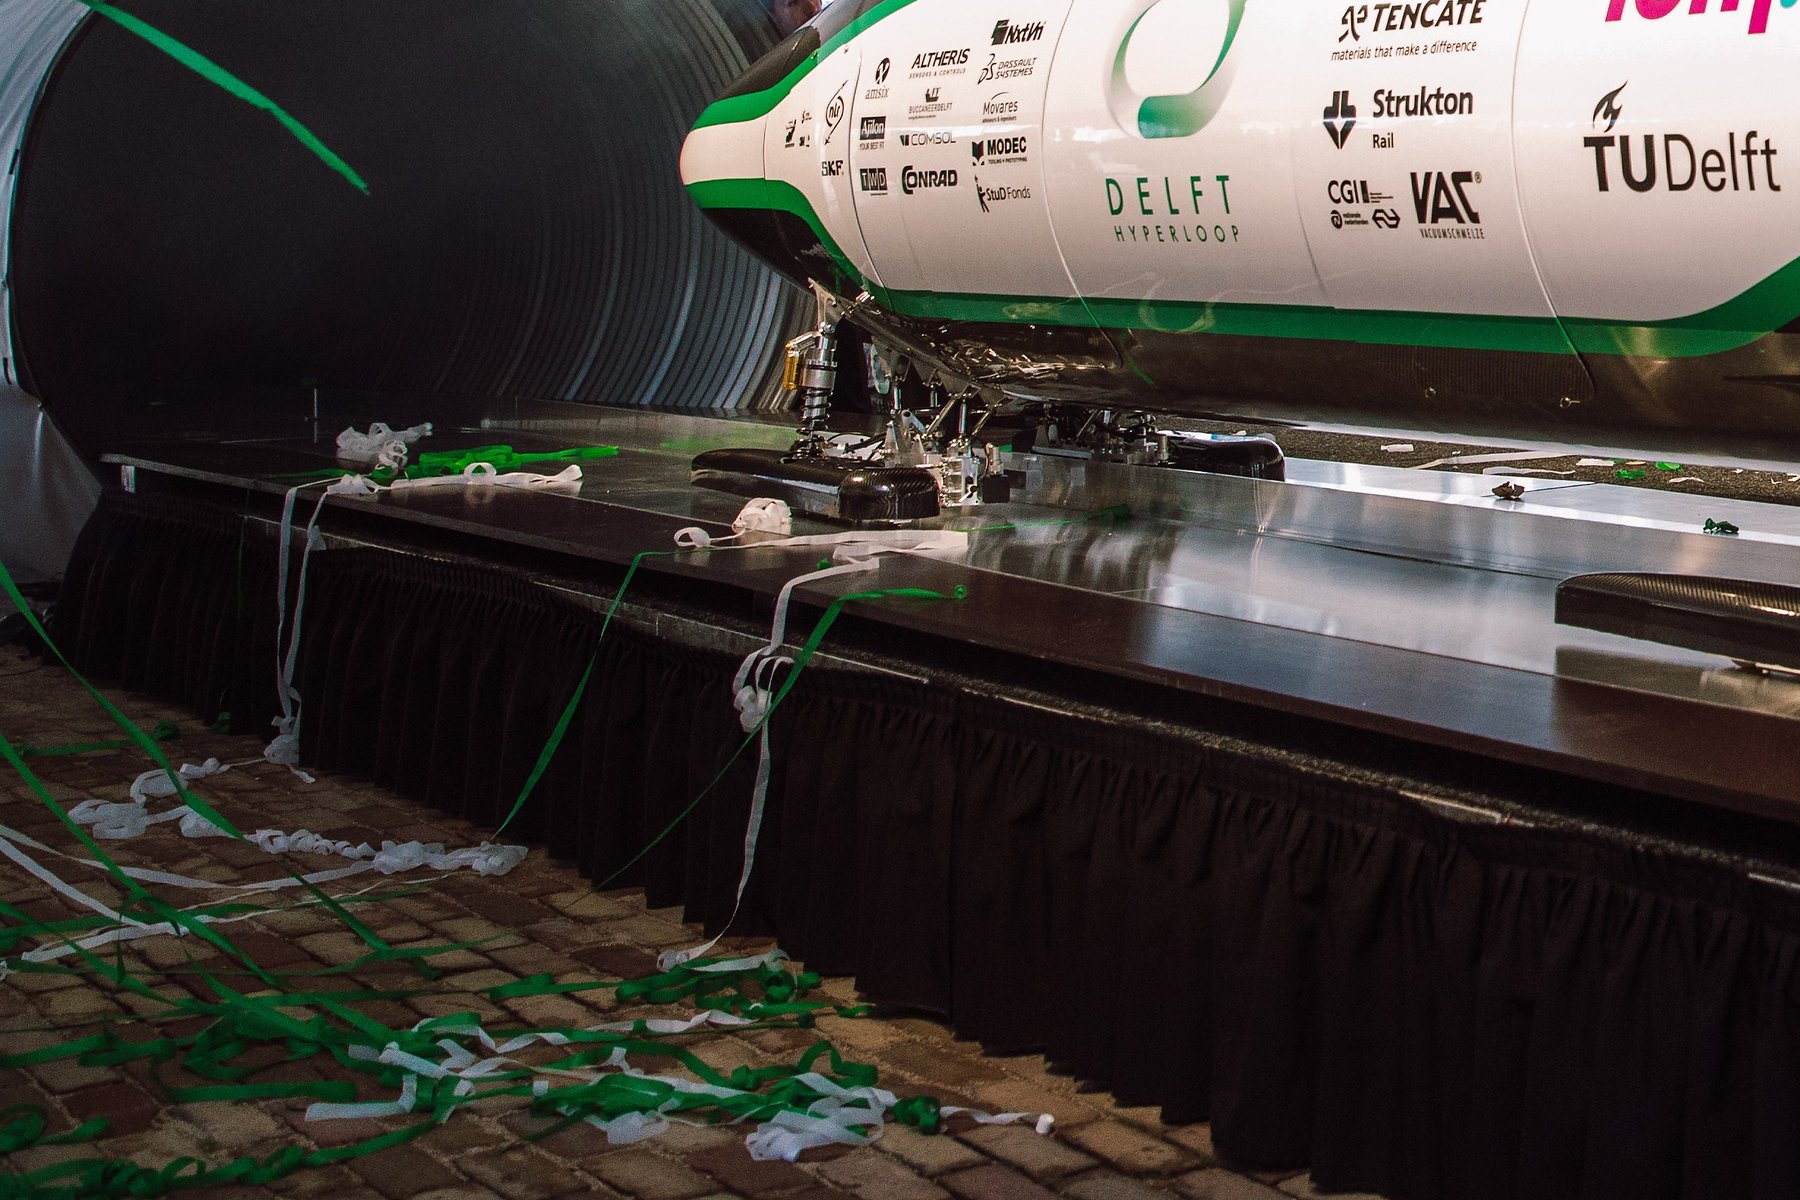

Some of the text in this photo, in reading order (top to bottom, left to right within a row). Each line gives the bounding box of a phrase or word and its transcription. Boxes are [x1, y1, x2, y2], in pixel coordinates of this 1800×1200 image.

[911, 48, 971, 70] ALTHERIS
[1330, 40, 1478, 61] materials that make a difference
[998, 57, 1038, 70] DASSAULT
[865, 85, 890, 100] amsix
[983, 100, 1019, 115] Movares
[1372, 86, 1474, 118] Strukton
[861, 120, 885, 137] Ajilon
[911, 132, 957, 146] COMSOL
[987, 136, 1027, 156] MODEC
[1372, 132, 1394, 149] Rail
[821, 160, 844, 176] SKF
[860, 171, 887, 188] TWD
[901, 165, 958, 195] CONRAD
[1105, 175, 1230, 215] DELFT
[1327, 179, 1359, 205] CGI
[1113, 225, 1239, 242] HYPERLOOP
[1420, 227, 1485, 240] VACUUMSCHMELZE
